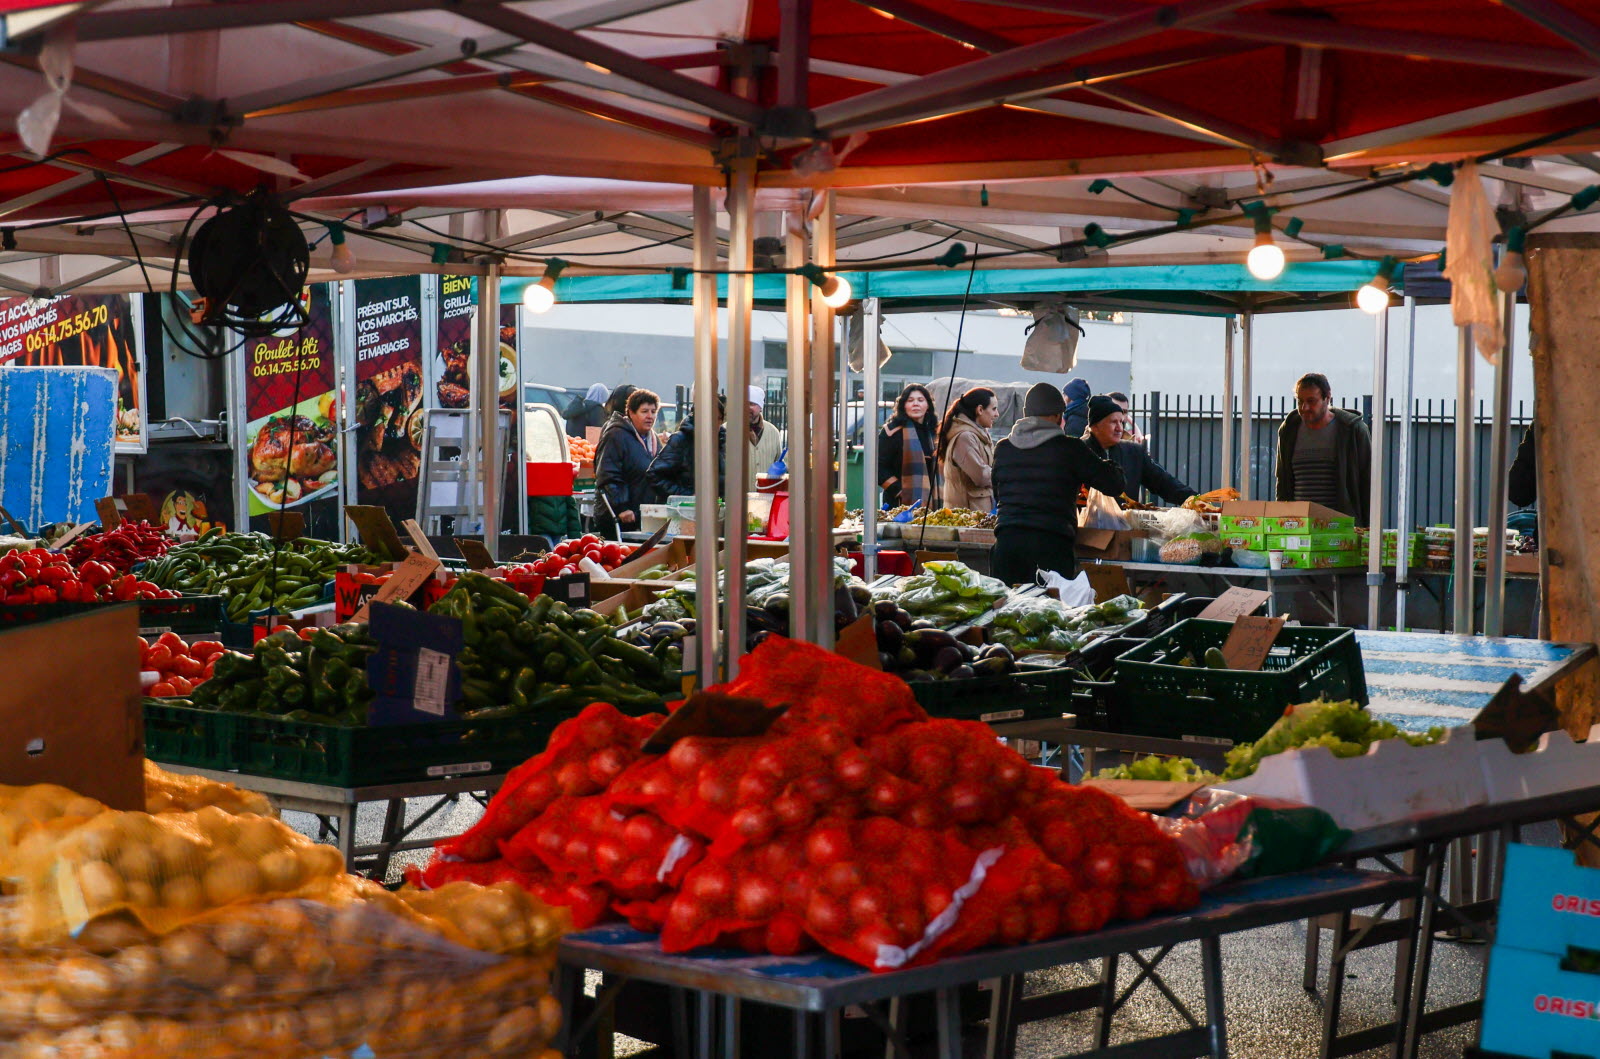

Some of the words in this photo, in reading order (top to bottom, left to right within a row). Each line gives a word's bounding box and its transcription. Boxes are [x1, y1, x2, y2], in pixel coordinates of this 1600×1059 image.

[357, 299, 392, 319] PRÉSENT
[392, 296, 409, 309] SUR
[357, 318, 375, 332] VOS
[376, 305, 418, 328] MARCHÉS,
[443, 305, 473, 319] ACCOMP
[2, 324, 19, 341] VOS
[20, 307, 58, 335] MARCHÉS
[26, 304, 108, 352] 06.14.75.56.70
[358, 331, 379, 347] FÊTES
[358, 348, 368, 362] ET
[368, 338, 410, 359] MARIAGES
[254, 339, 294, 364] Poulet
[253, 358, 320, 377] 06.14.75.56.70
